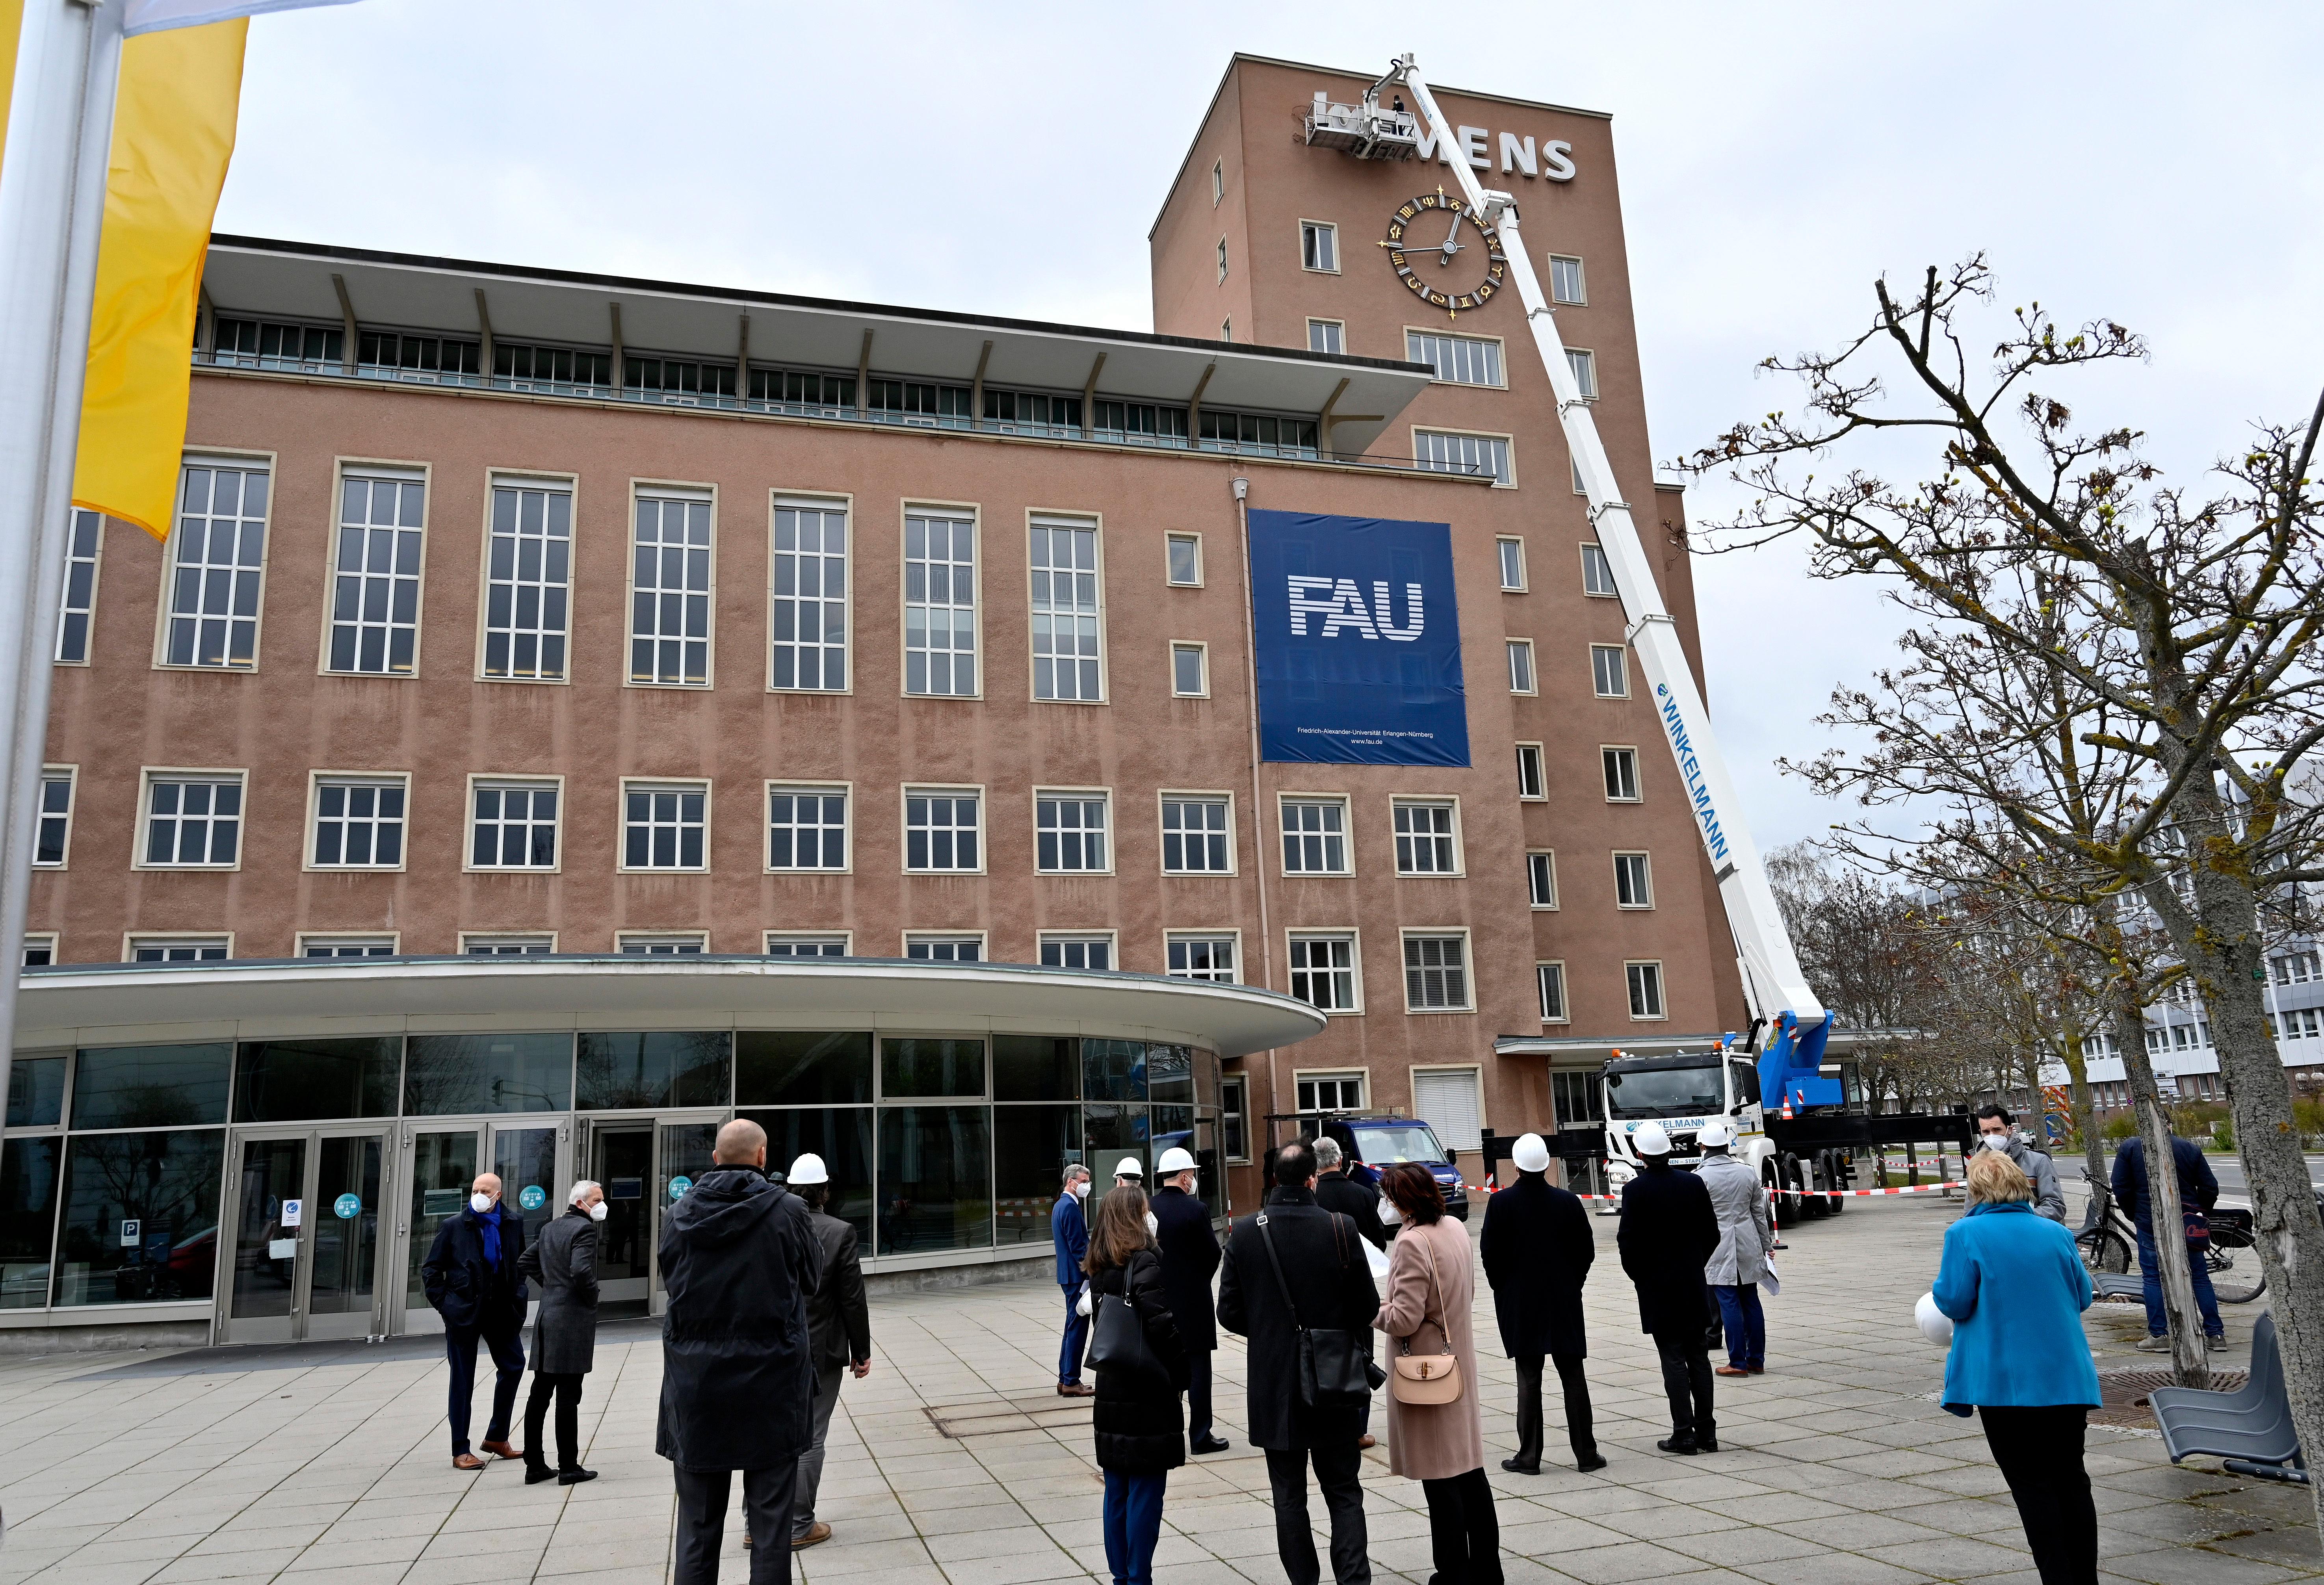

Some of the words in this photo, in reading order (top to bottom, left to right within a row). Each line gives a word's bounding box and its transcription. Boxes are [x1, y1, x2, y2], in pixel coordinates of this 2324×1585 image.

[1288, 575, 1424, 641] FAU
[1298, 728, 1381, 736] Friedrich-Alexander-Universität
[1383, 730, 1433, 739] Erlangen-Nürnberg
[1663, 696, 1728, 860] WINKELMANN
[1637, 1118, 1705, 1128] KELMANN
[127, 1224, 135, 1234] P
